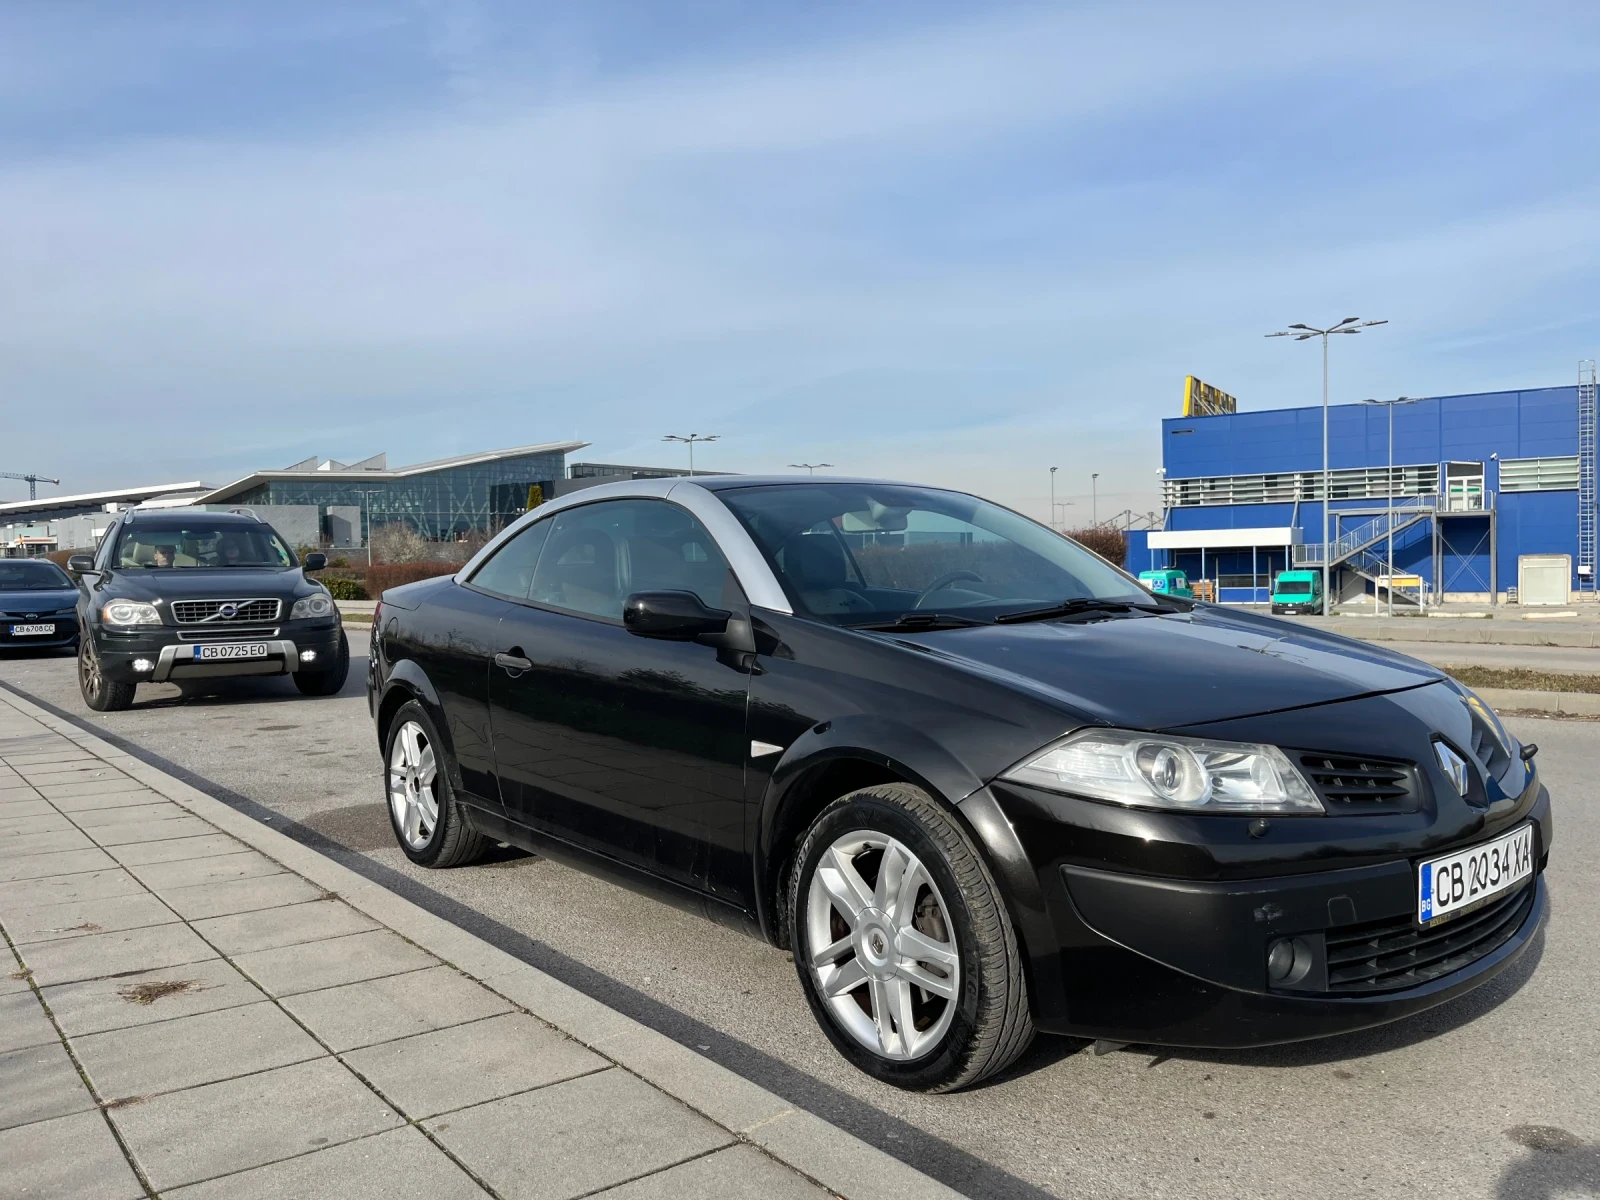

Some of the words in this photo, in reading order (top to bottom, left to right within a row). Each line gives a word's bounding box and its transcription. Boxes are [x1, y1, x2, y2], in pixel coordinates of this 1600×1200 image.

[44, 624, 54, 632] CC
[202, 647, 218, 658] CB
[220, 645, 248, 657] 0725
[250, 645, 265, 655] EO
[1436, 861, 1465, 908] CB
[1468, 841, 1510, 897] 2034
[1512, 832, 1530, 877] XA
[1421, 898, 1431, 912] BG
